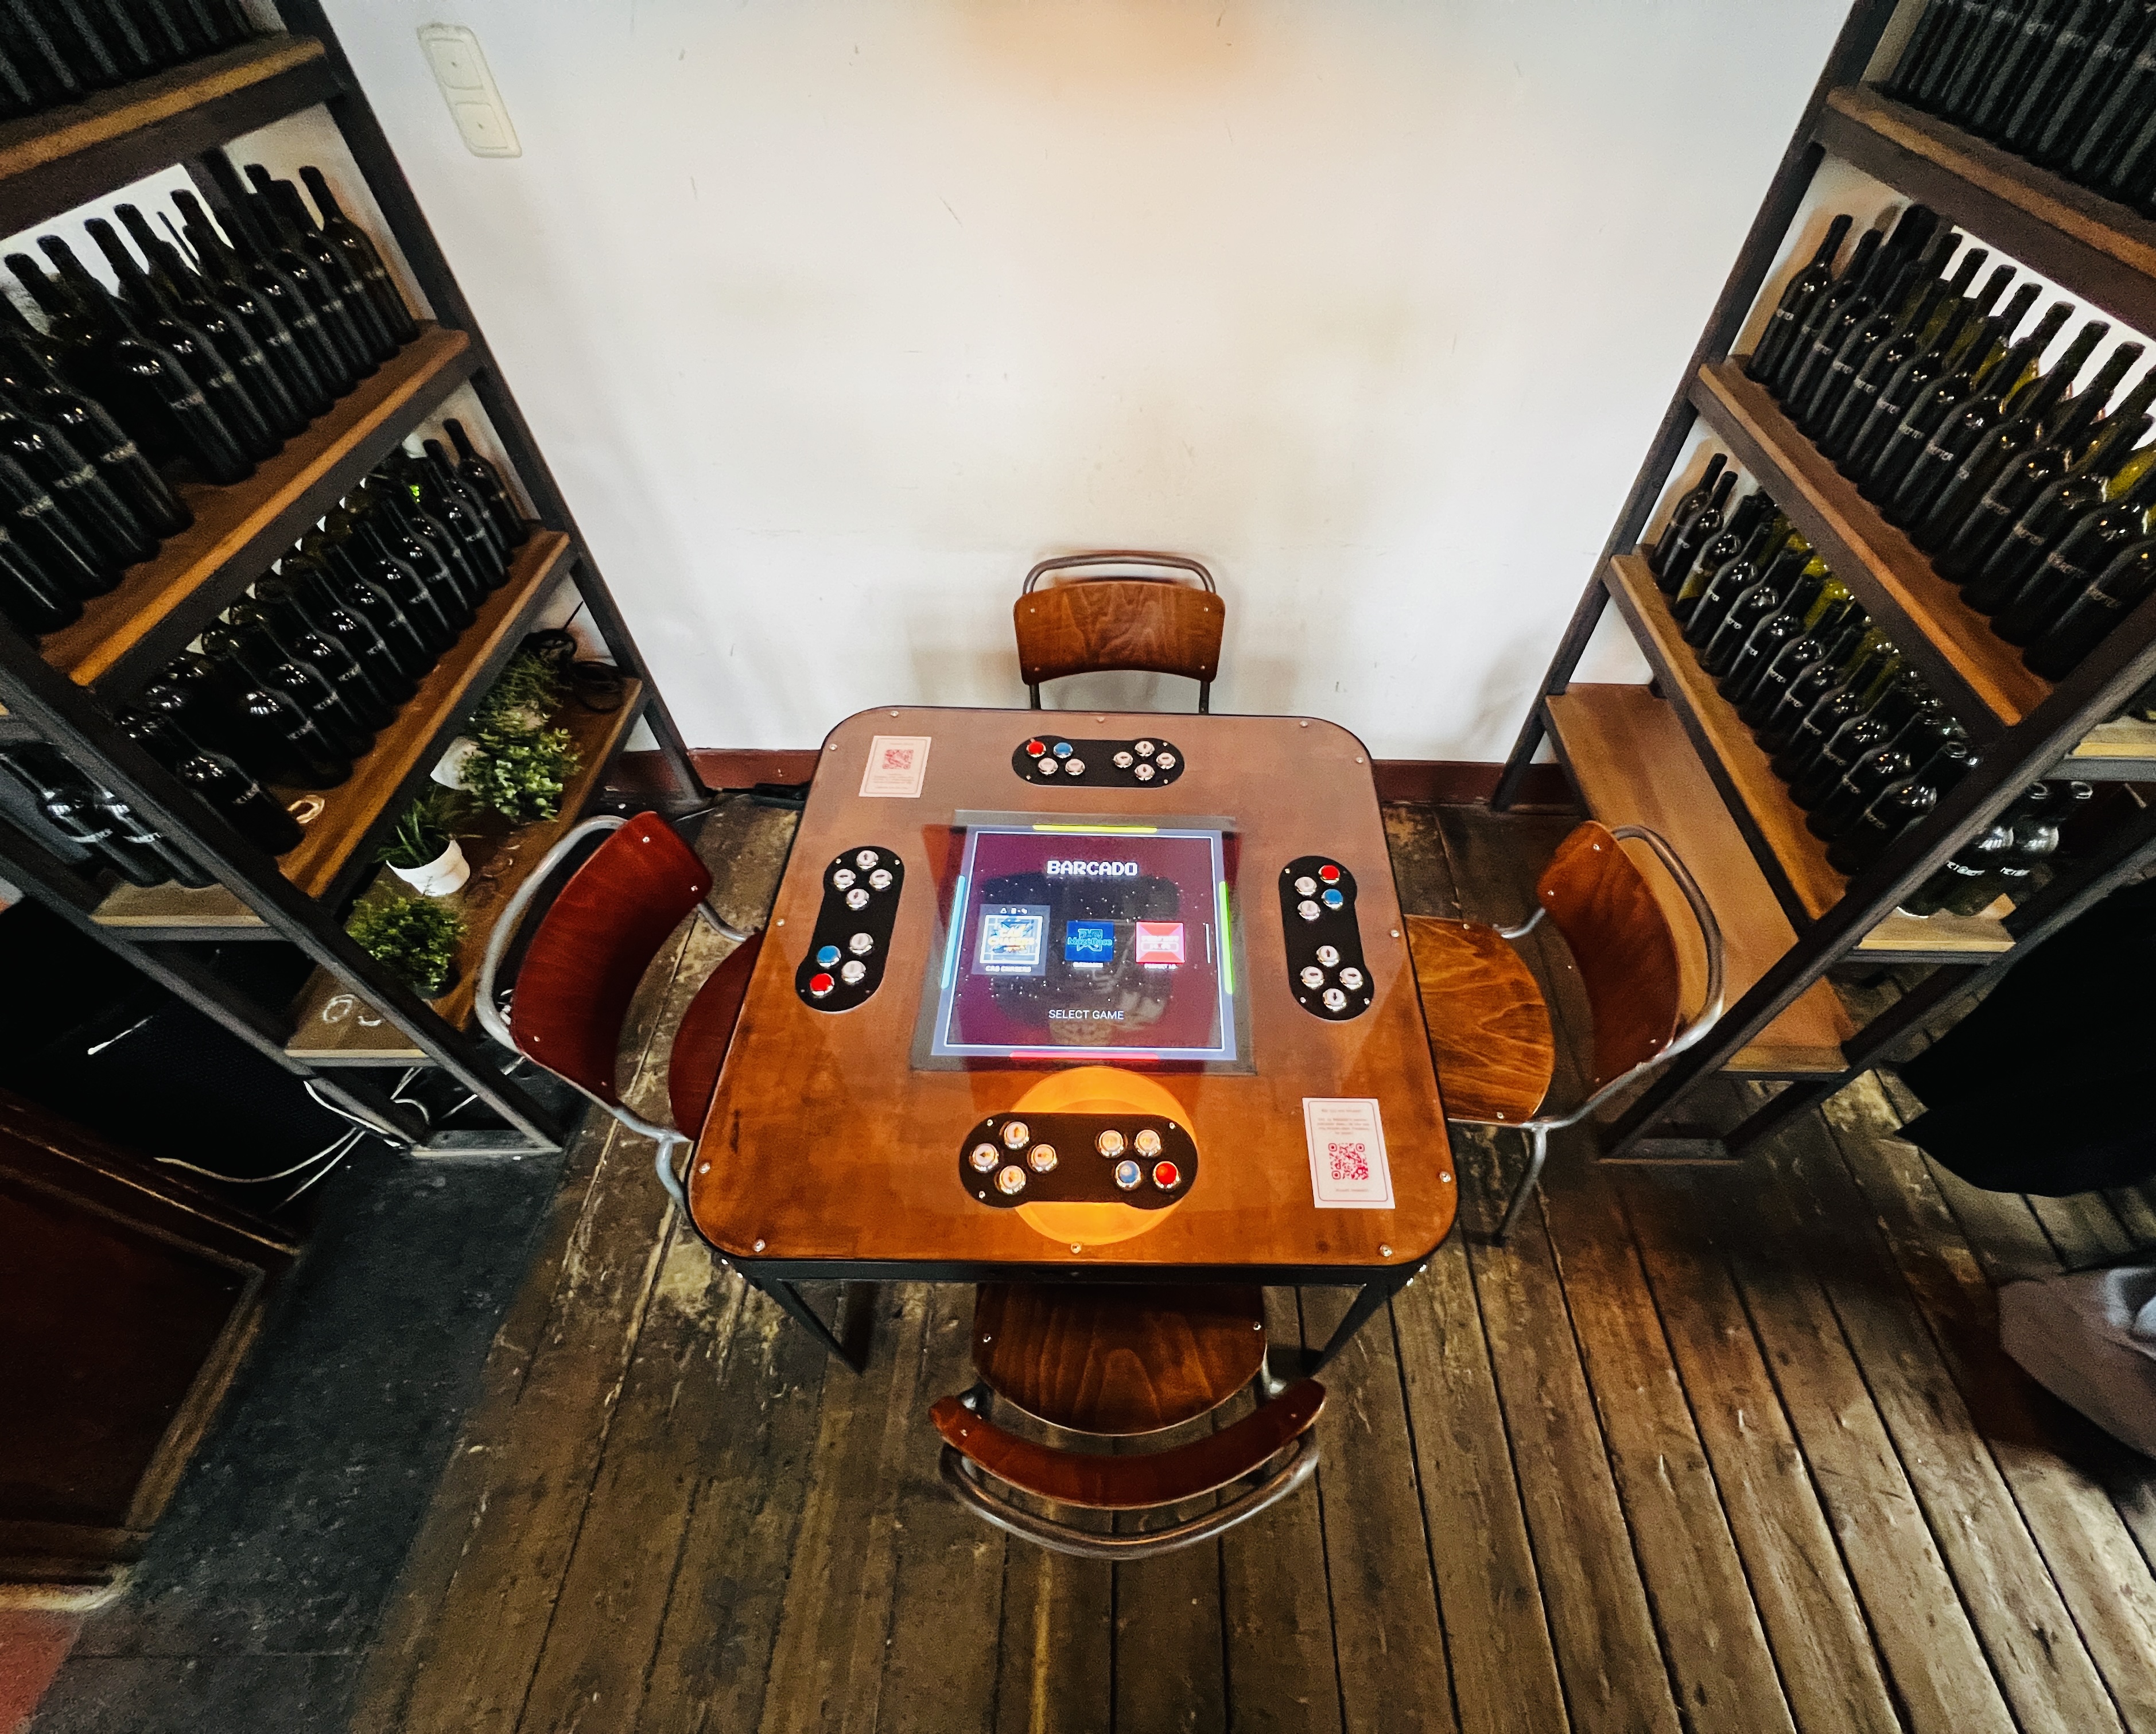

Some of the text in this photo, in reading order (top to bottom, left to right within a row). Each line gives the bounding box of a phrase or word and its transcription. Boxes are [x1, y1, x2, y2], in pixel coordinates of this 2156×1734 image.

[1047, 860, 1138, 876] BARCADO
[1048, 1009, 1124, 1020] SELECT GAME
